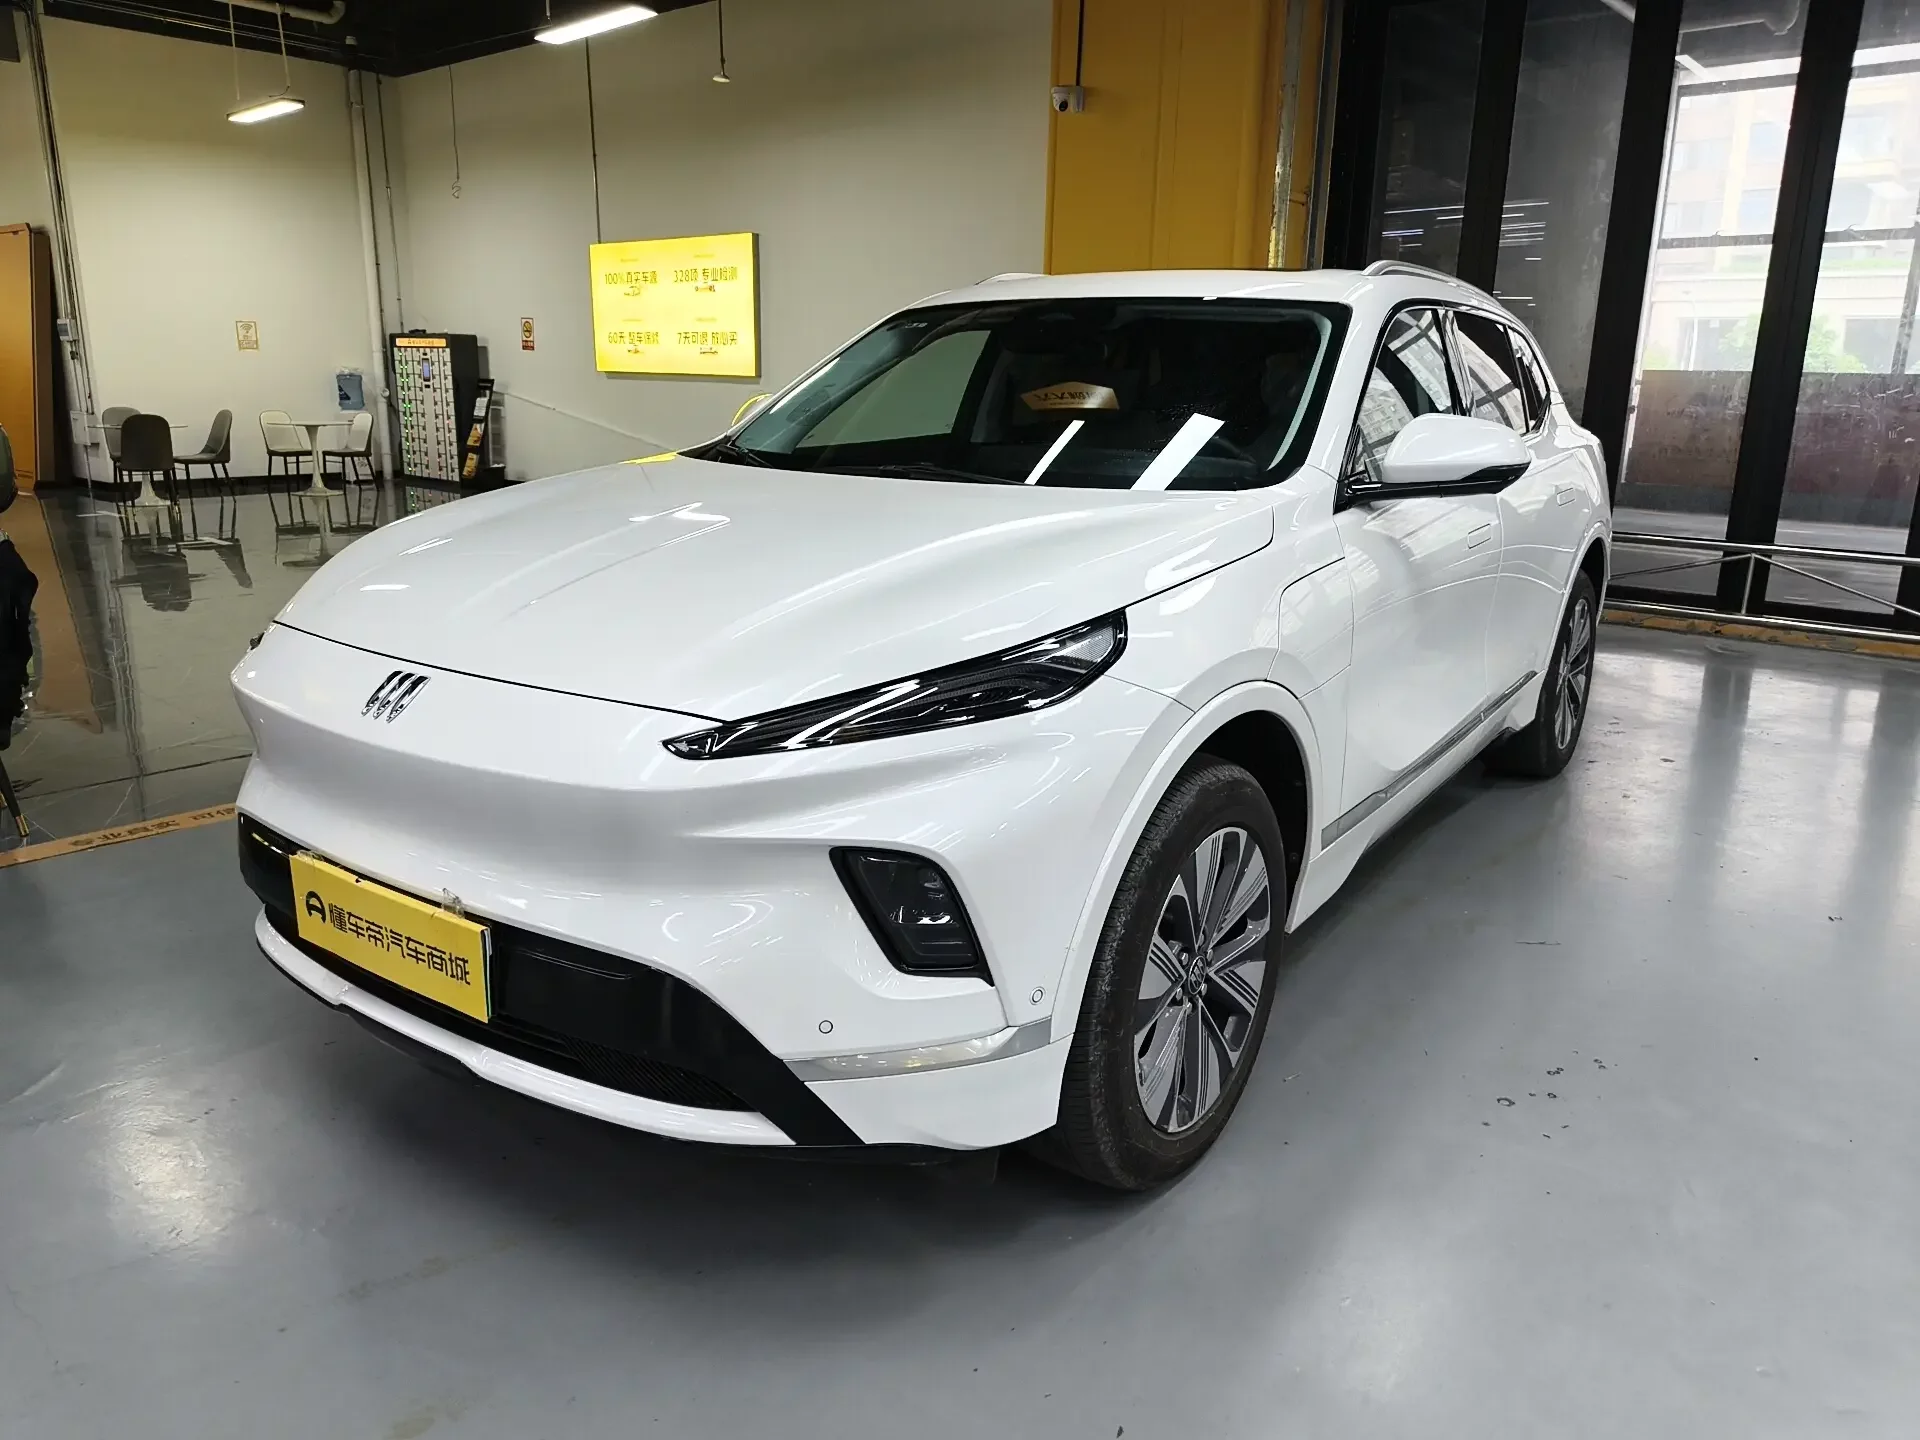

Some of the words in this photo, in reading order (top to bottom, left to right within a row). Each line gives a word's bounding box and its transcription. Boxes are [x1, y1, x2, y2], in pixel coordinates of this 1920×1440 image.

[673, 268, 698, 283] 328项
[702, 266, 737, 281] 专业检测
[608, 331, 626, 345] 60天
[677, 331, 708, 346] 7天可退
[711, 331, 737, 346] 放心买
[329, 902, 471, 986] 懂车帝汽车商城
